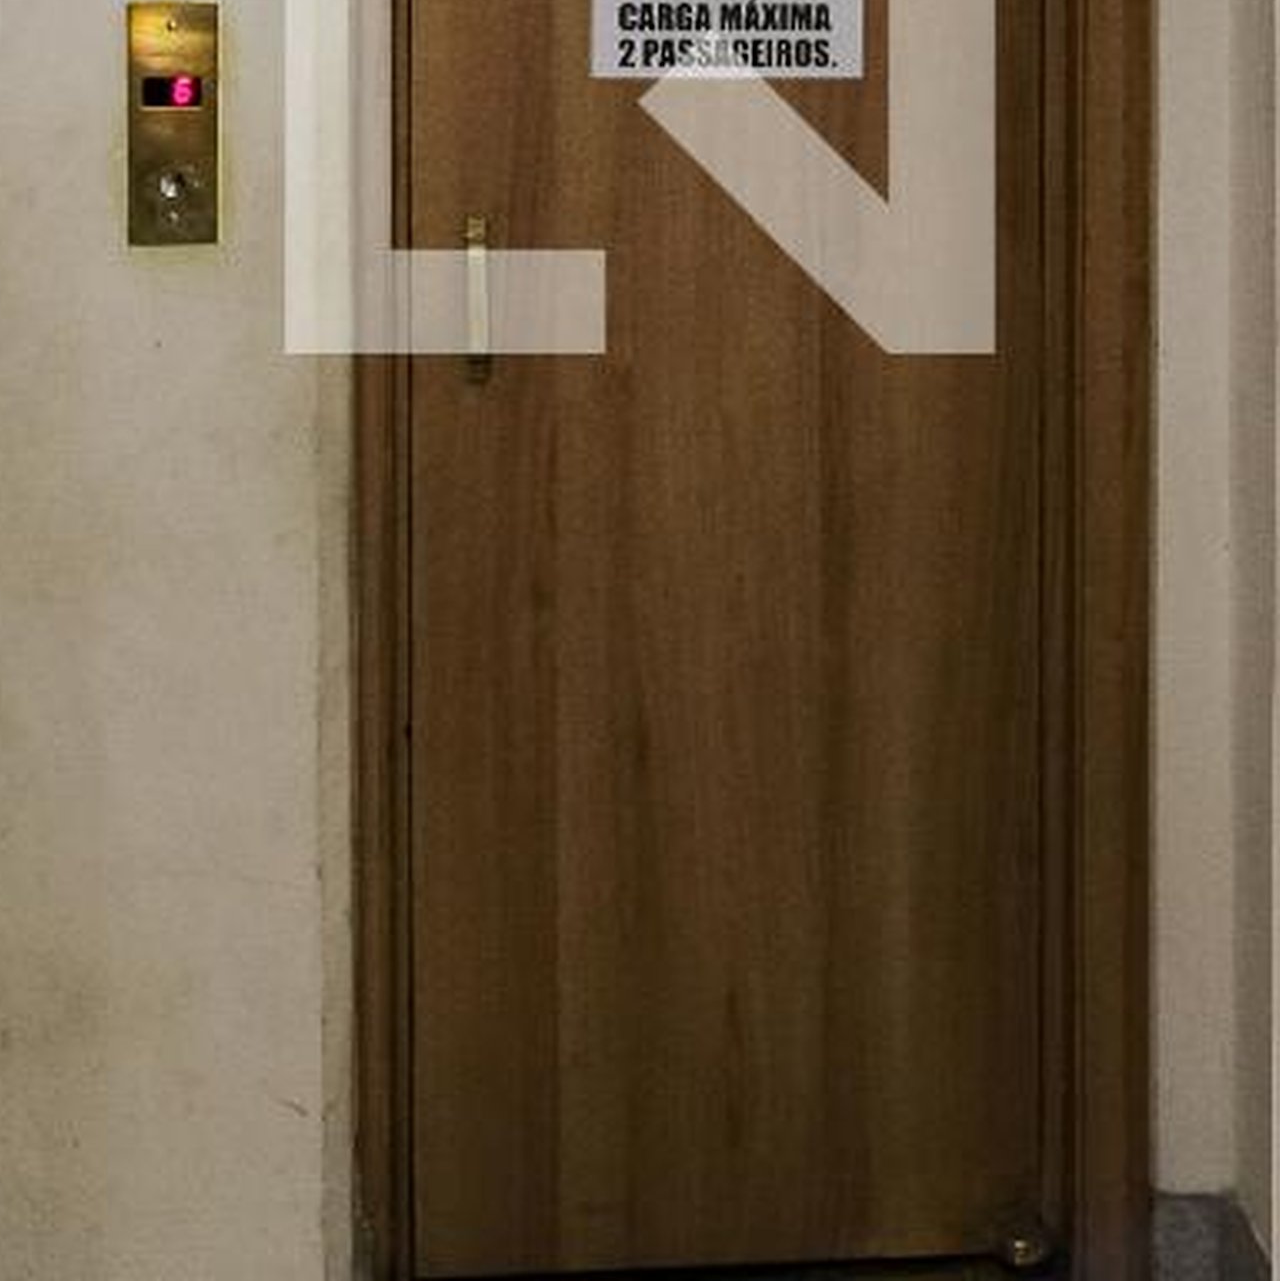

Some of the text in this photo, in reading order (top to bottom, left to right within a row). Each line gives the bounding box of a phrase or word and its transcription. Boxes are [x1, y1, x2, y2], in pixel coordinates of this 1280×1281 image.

[618, 3, 712, 32] CARGA
[618, 39, 636, 67] 2
[174, 77, 193, 104] 6
